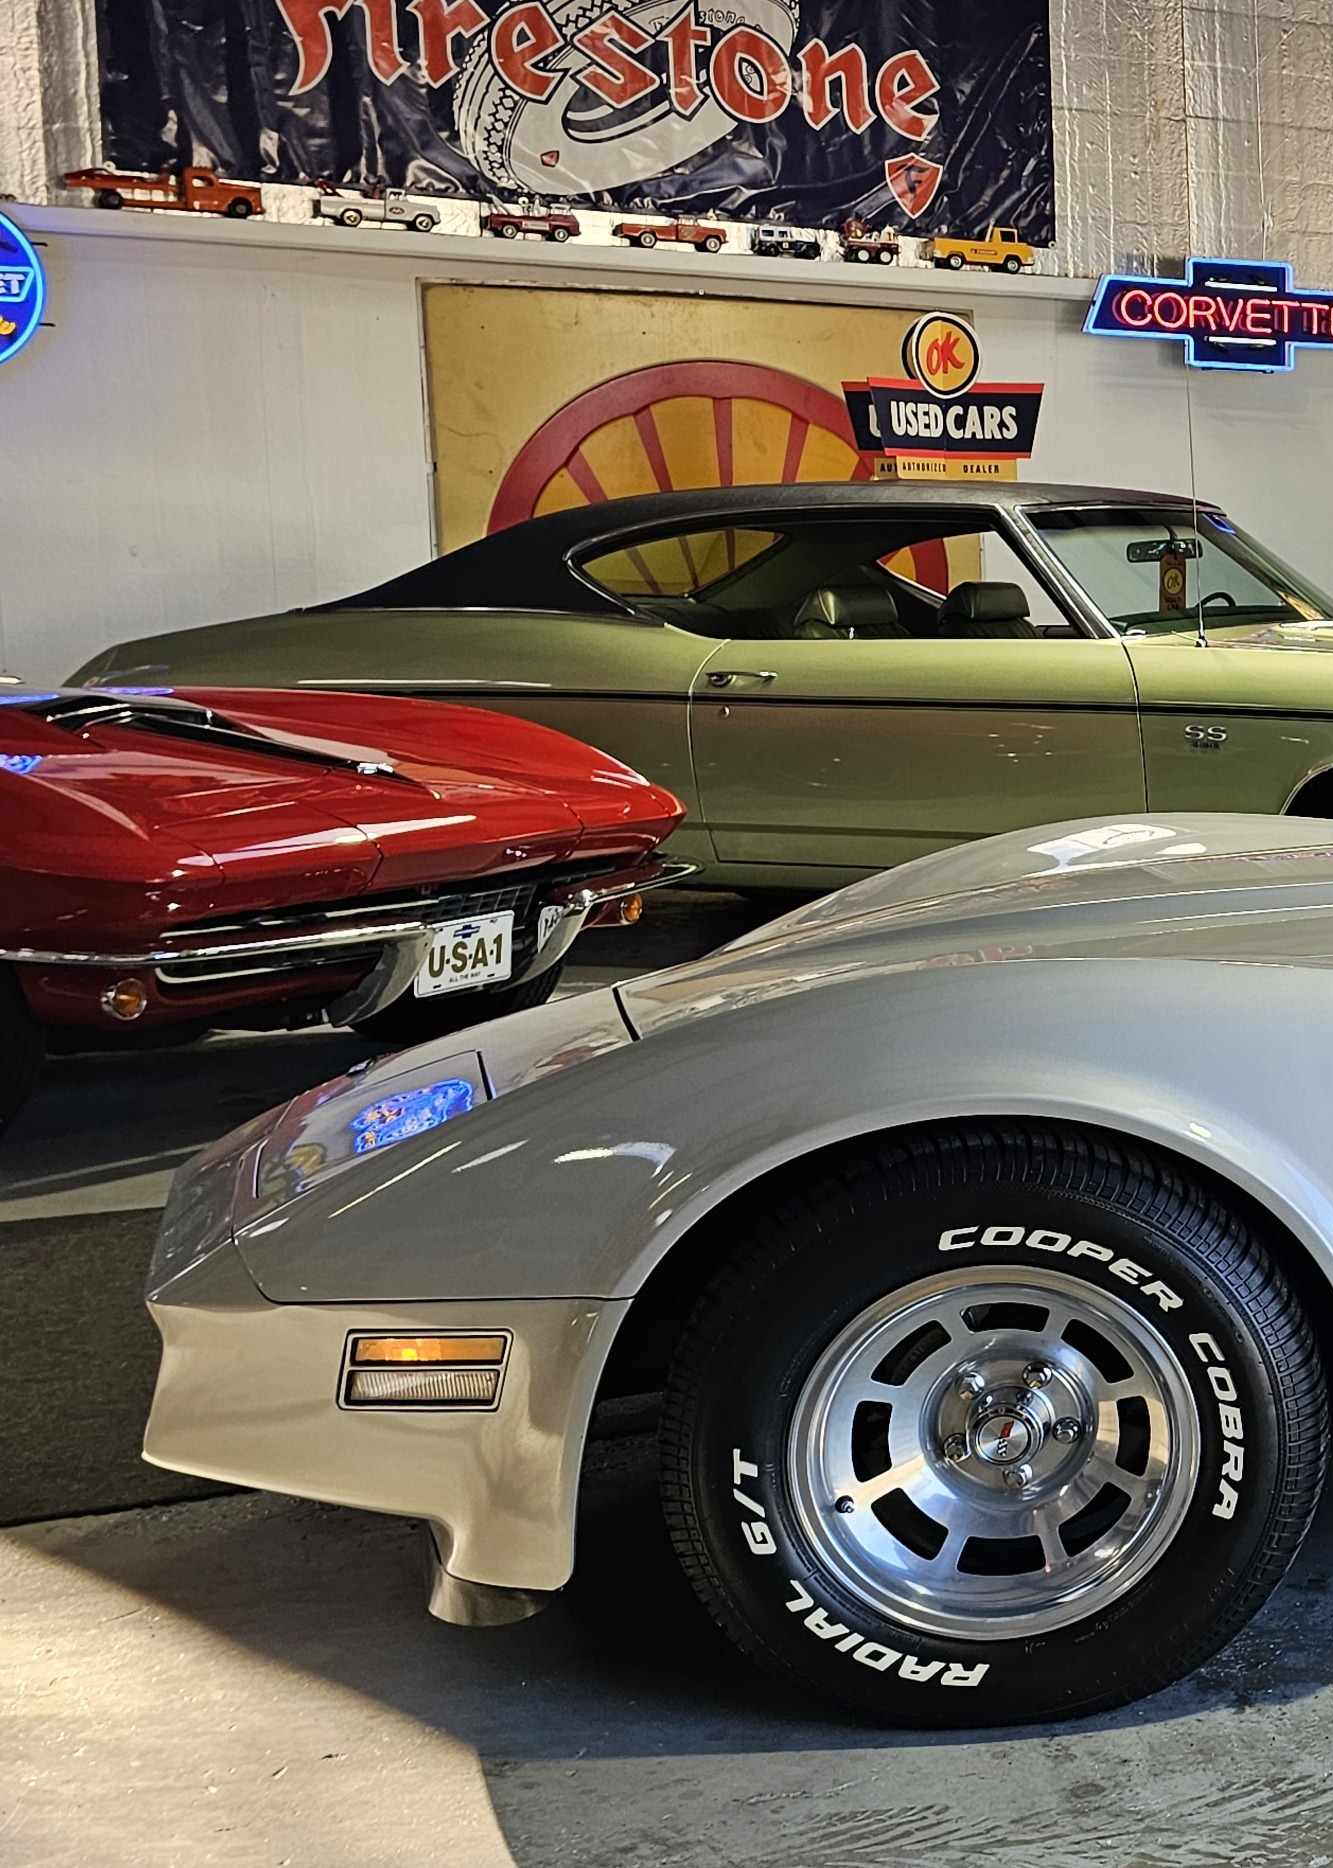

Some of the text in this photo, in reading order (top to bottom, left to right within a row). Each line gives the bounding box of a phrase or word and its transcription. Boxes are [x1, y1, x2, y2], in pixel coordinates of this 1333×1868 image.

[926, 331, 965, 376] OK
[890, 400, 944, 438] USED
[945, 405, 1018, 440] CARS
[902, 461, 946, 473] AUTHORIZED
[963, 464, 1000, 474] DEALER
[1185, 725, 1226, 741] SS
[460, 972, 469, 980] THE
[938, 1225, 1245, 1520] COOPER COBRA
[732, 1447, 777, 1556] G/T
[784, 1579, 990, 1687] RADIAL
